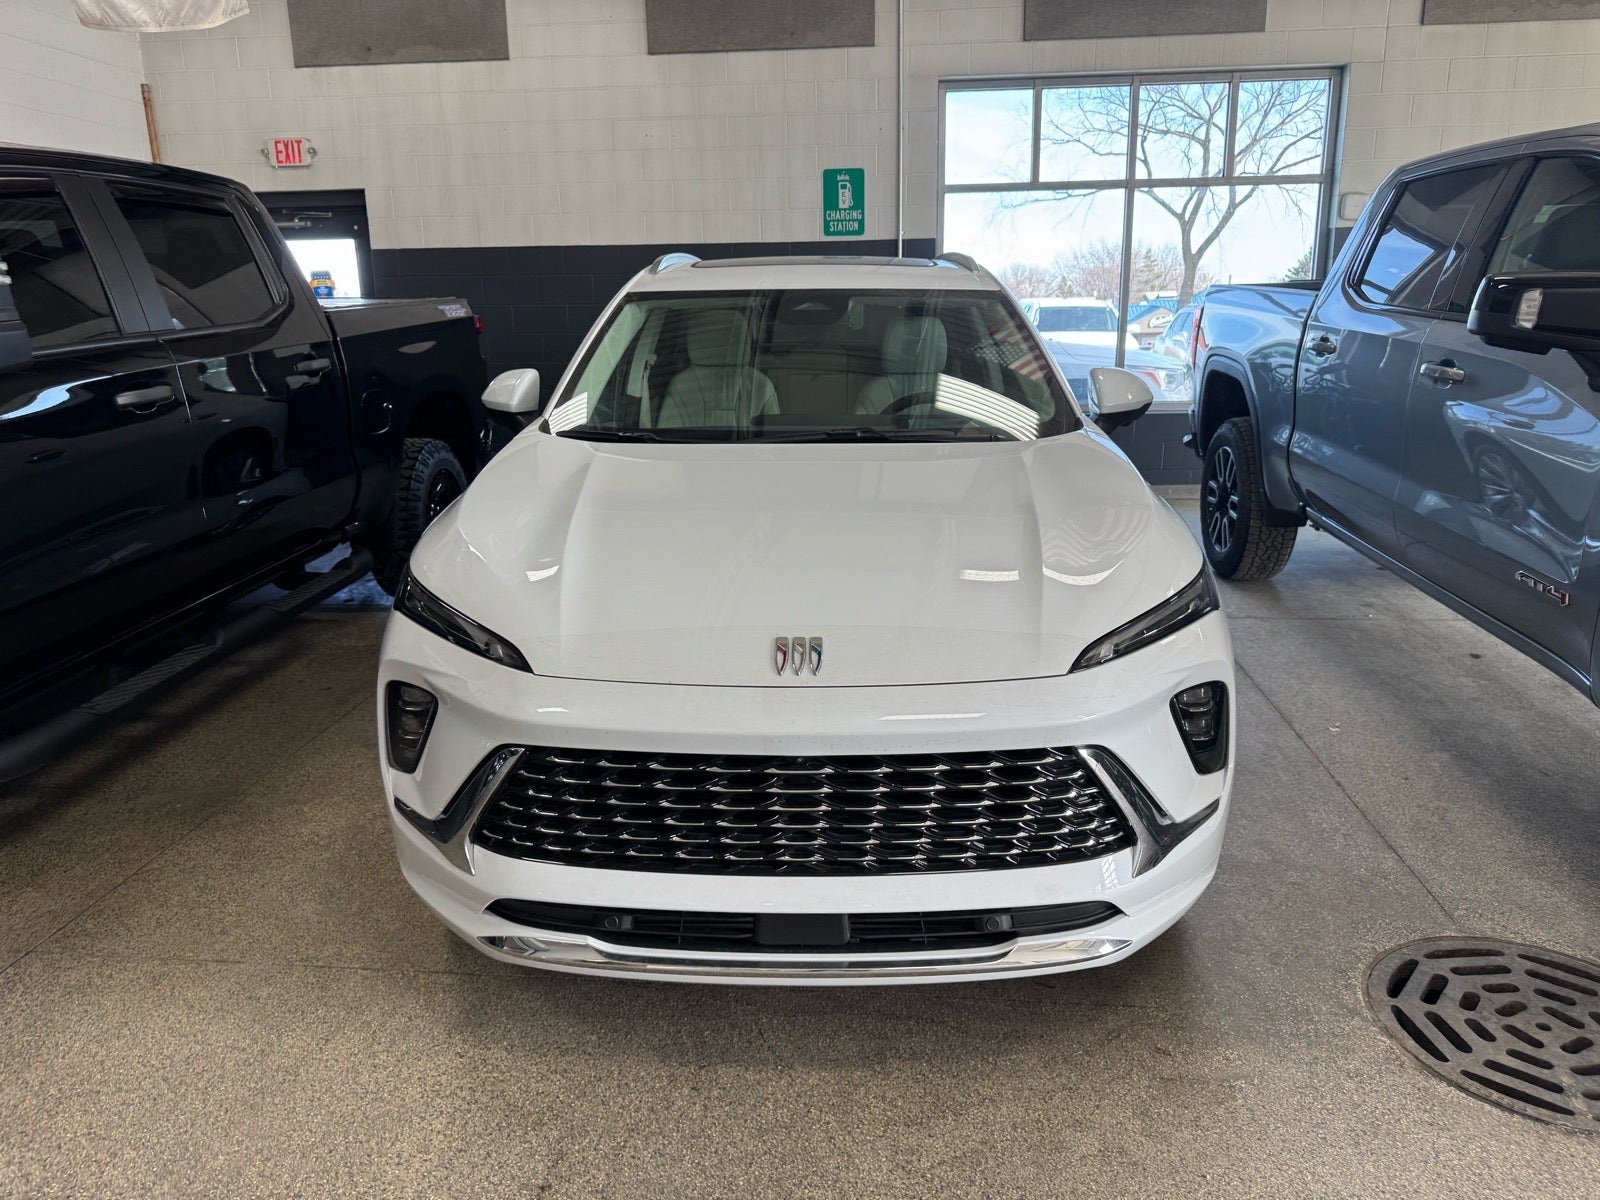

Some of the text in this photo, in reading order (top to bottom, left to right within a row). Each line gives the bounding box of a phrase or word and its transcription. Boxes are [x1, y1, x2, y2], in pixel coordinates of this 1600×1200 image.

[274, 139, 303, 164] EXIT
[826, 210, 862, 220] CHARGING
[829, 221, 859, 232] STATION
[1515, 570, 1570, 607] AT4
